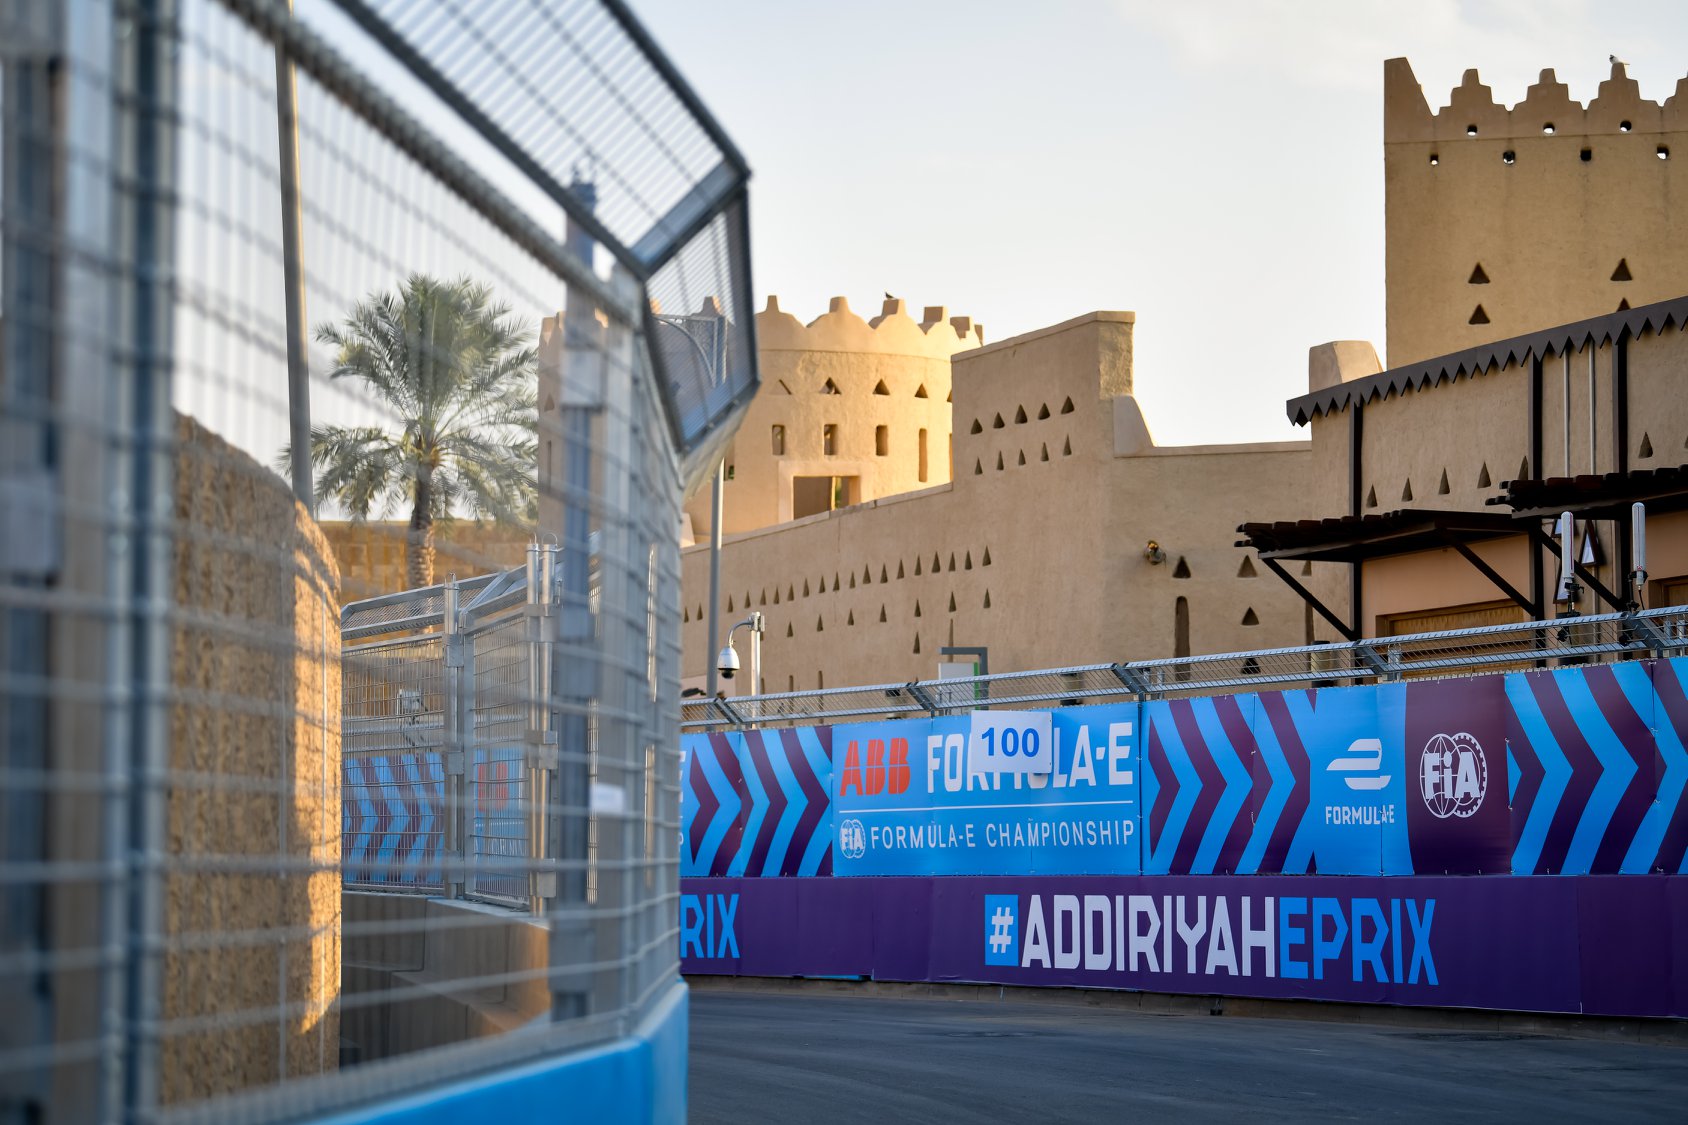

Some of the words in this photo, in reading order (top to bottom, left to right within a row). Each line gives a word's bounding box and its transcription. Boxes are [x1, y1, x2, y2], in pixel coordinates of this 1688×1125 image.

[981, 727, 1040, 758] 100
[840, 737, 911, 796] ABB
[986, 820, 1134, 847] CHAMPIONSHIP
